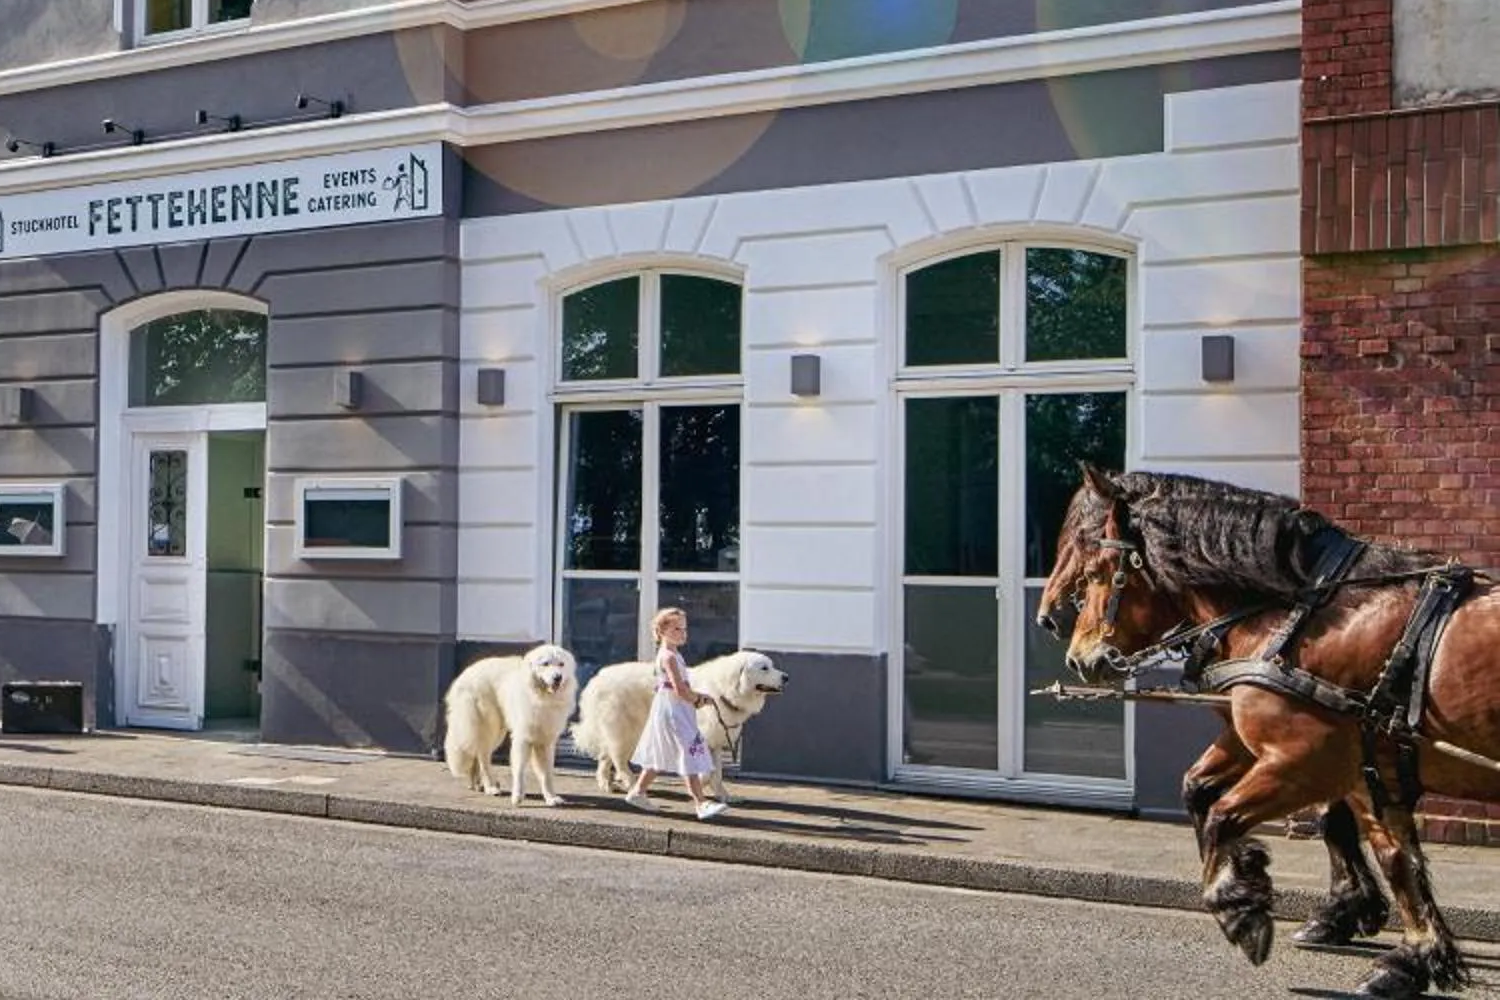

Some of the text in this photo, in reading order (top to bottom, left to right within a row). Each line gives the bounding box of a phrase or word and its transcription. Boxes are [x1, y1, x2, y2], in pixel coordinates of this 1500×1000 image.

[323, 168, 377, 189] EVENTS
[11, 176, 300, 236] STUCKHOTEL FETTEHENNE
[307, 191, 377, 213] CATERING
